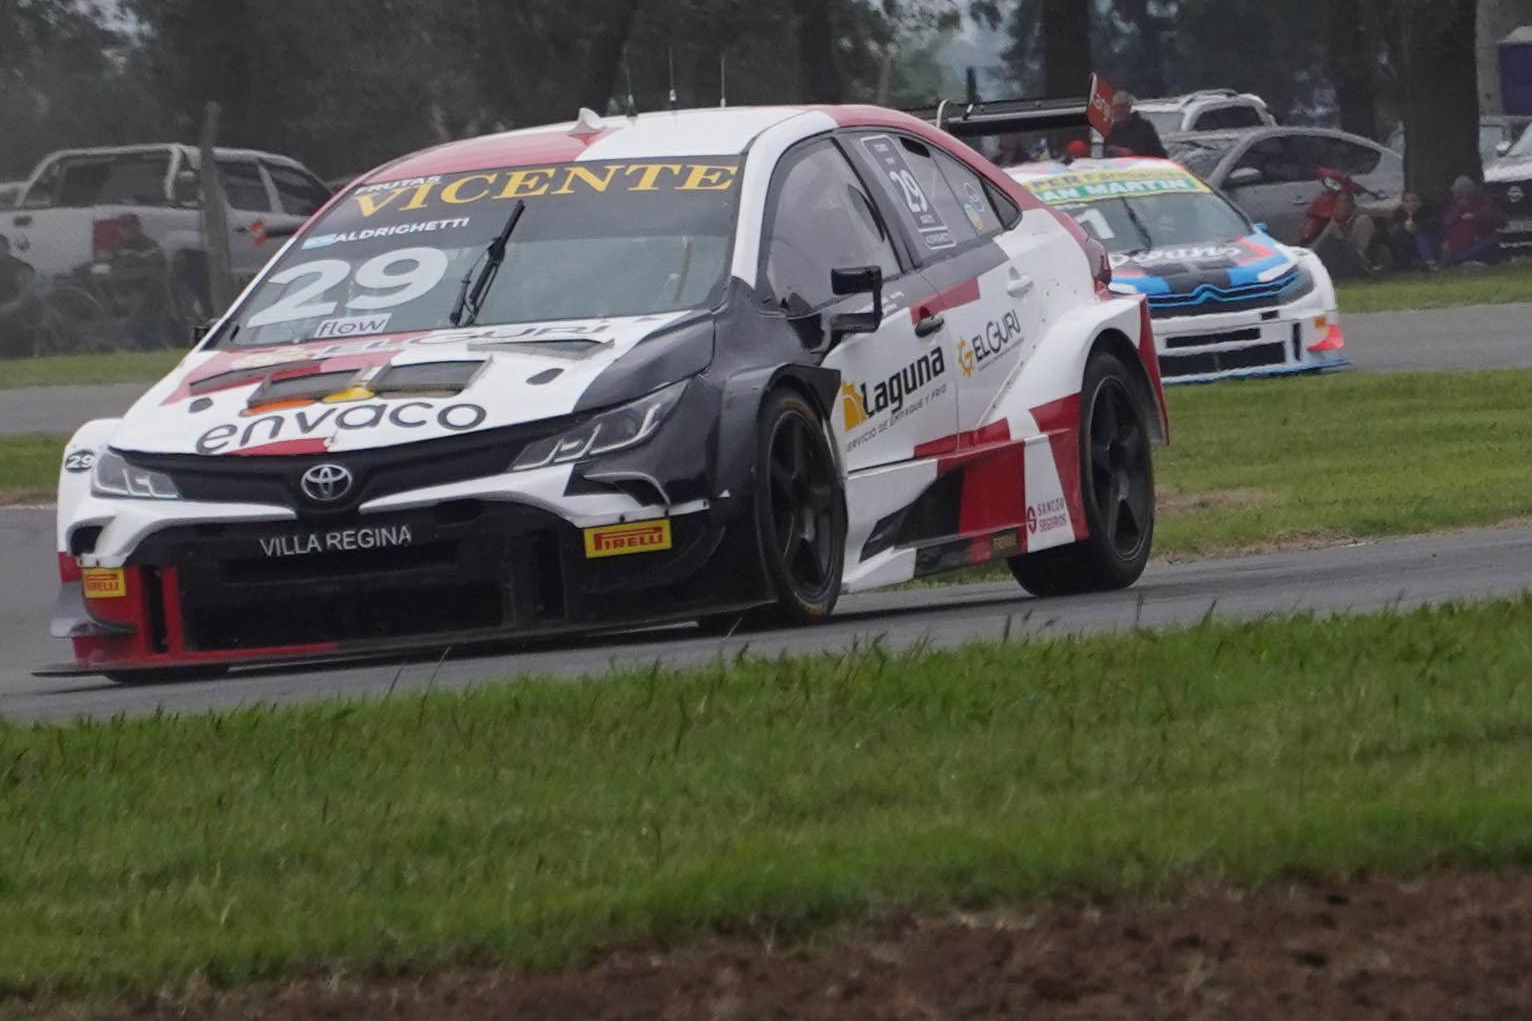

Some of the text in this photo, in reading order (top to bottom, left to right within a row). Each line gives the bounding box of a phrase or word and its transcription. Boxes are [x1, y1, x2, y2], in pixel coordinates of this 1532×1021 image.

[352, 163, 741, 218] VICENTE
[353, 175, 444, 195] FRUTAS
[889, 169, 928, 213] 29
[1086, 179, 1190, 196] MARTIN
[331, 217, 471, 245] ALDRIGHETTI
[245, 246, 449, 330] 29
[316, 318, 387, 339] flow
[859, 345, 946, 419] Laguna
[194, 402, 489, 455] envaco
[66, 454, 96, 470] 29
[258, 524, 413, 558] VILLA REGINA
[592, 525, 665, 552] PIRELLI
